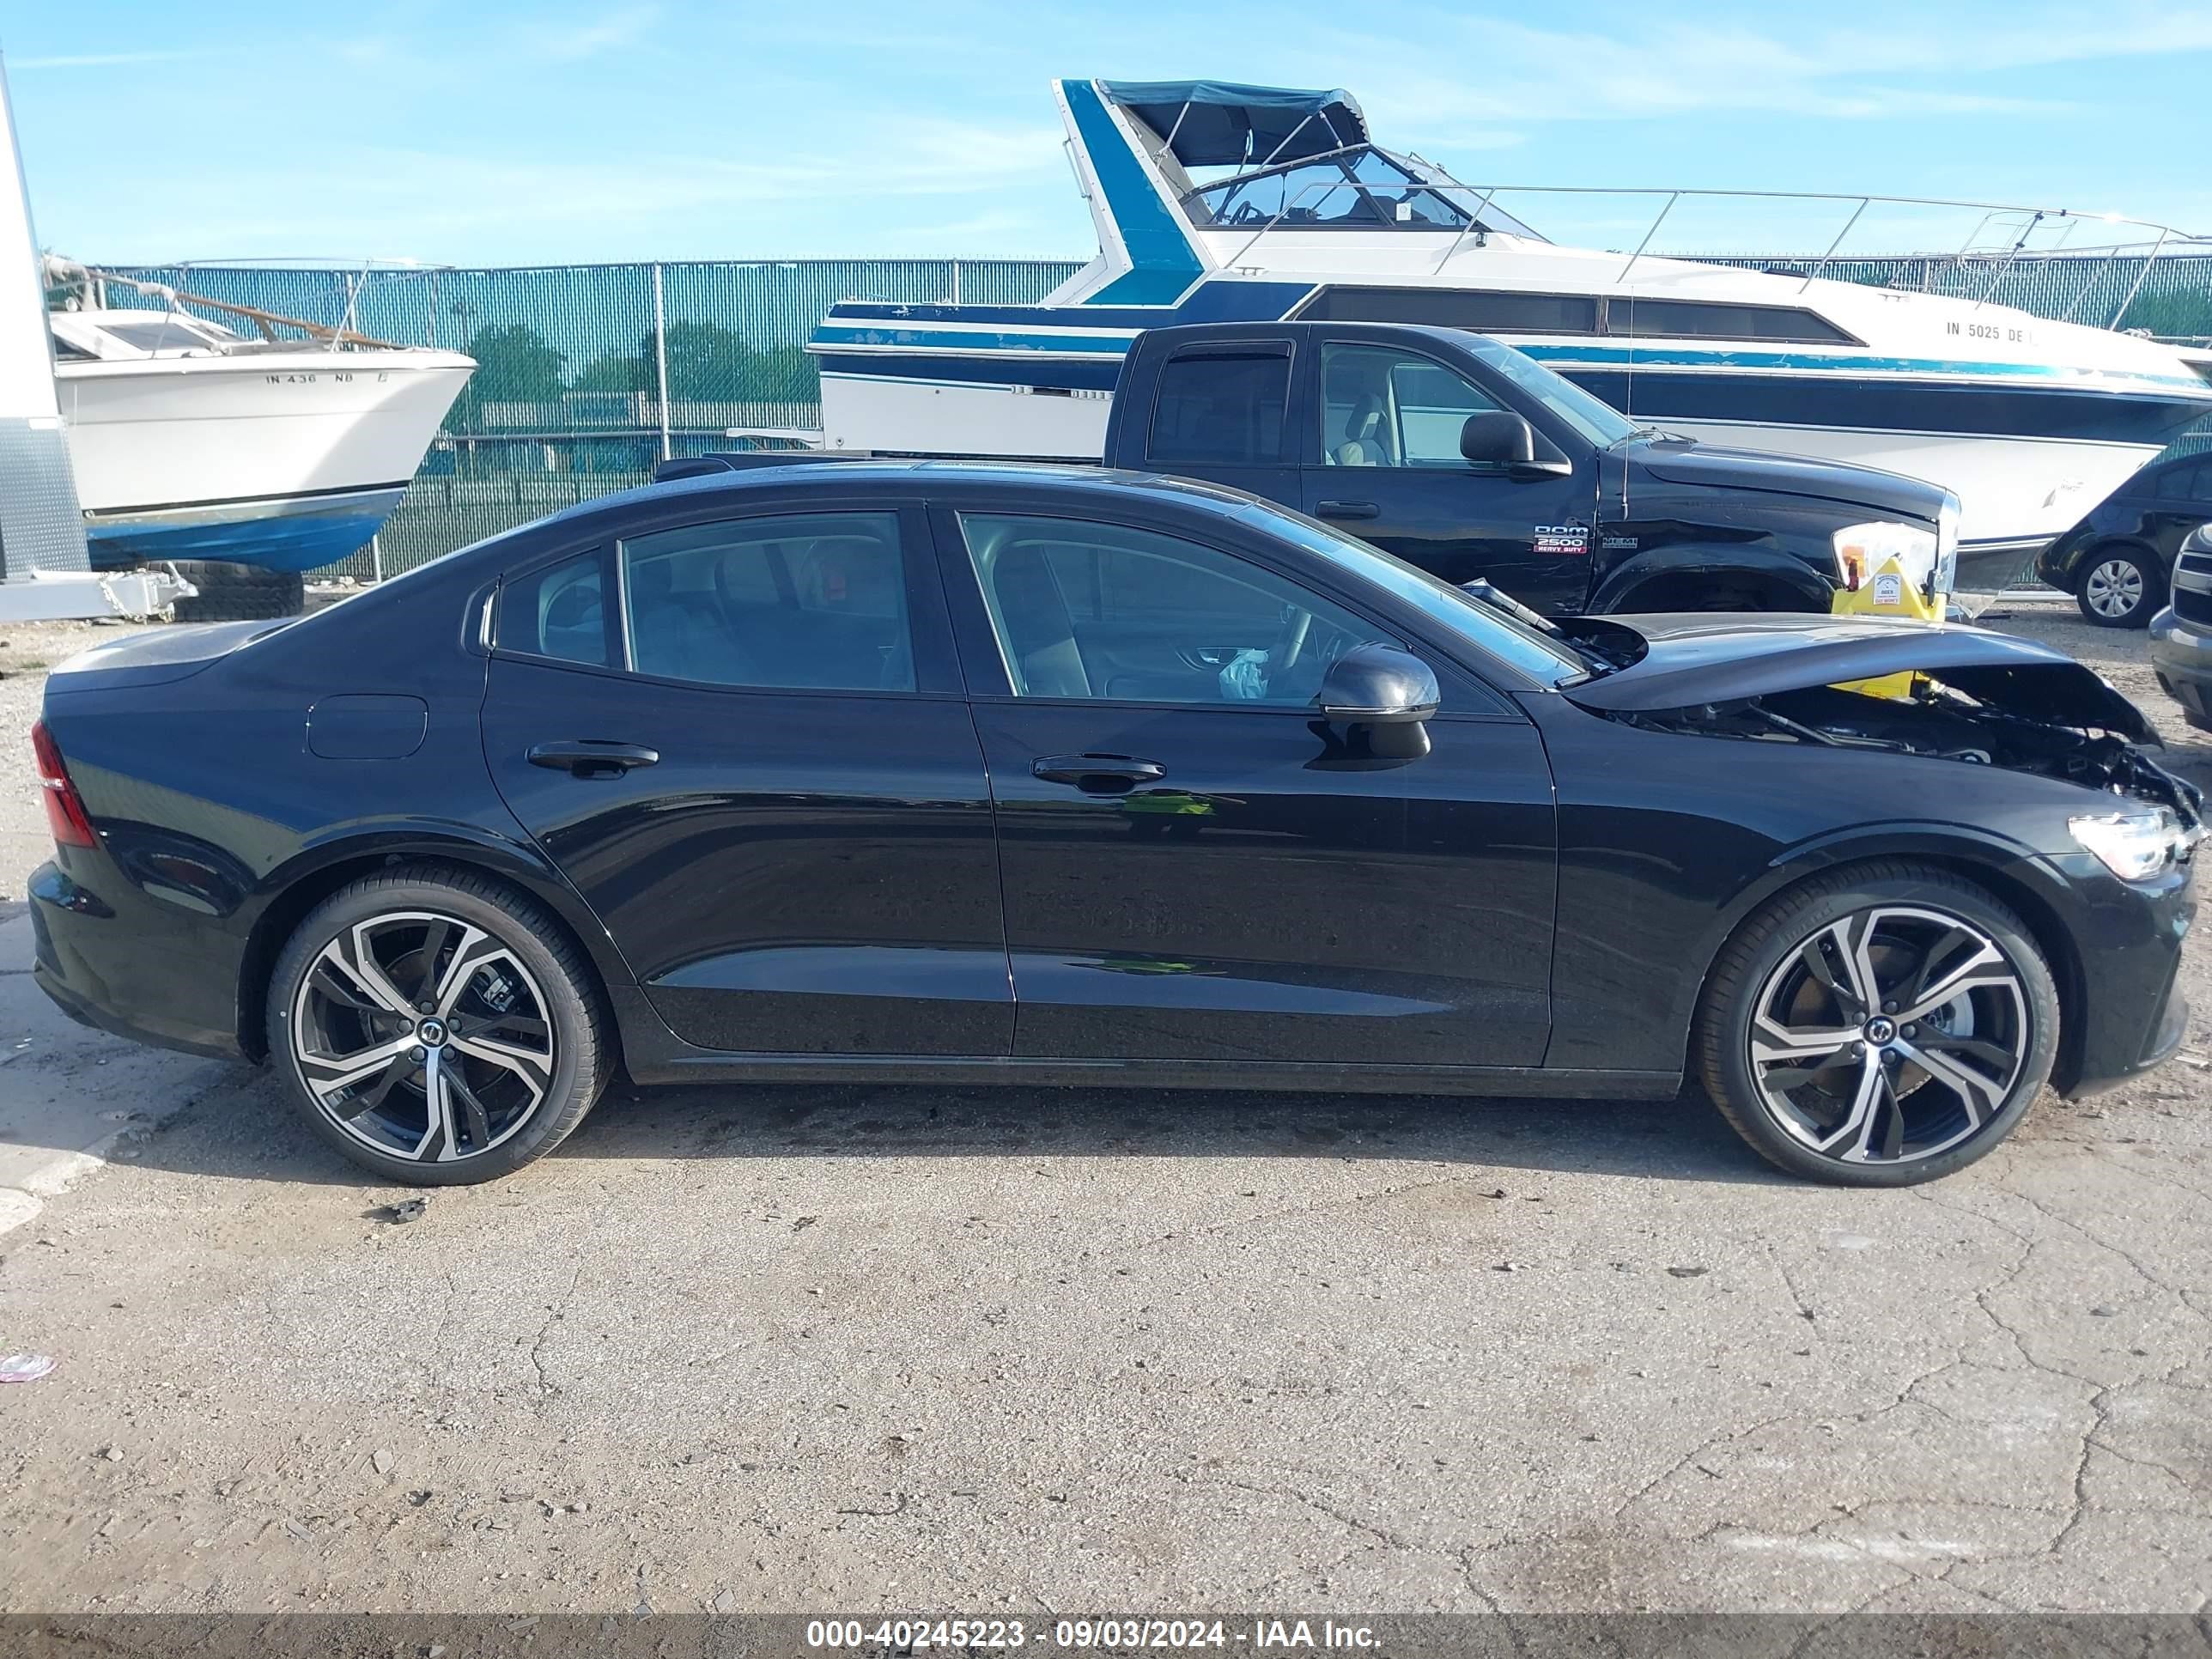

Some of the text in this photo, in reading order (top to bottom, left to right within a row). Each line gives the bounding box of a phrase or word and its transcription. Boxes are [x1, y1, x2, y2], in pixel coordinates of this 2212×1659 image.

[1946, 321, 2024, 343] IN 5025 DE
[266, 374, 281, 385] IN
[1537, 538, 1583, 547] 2500
